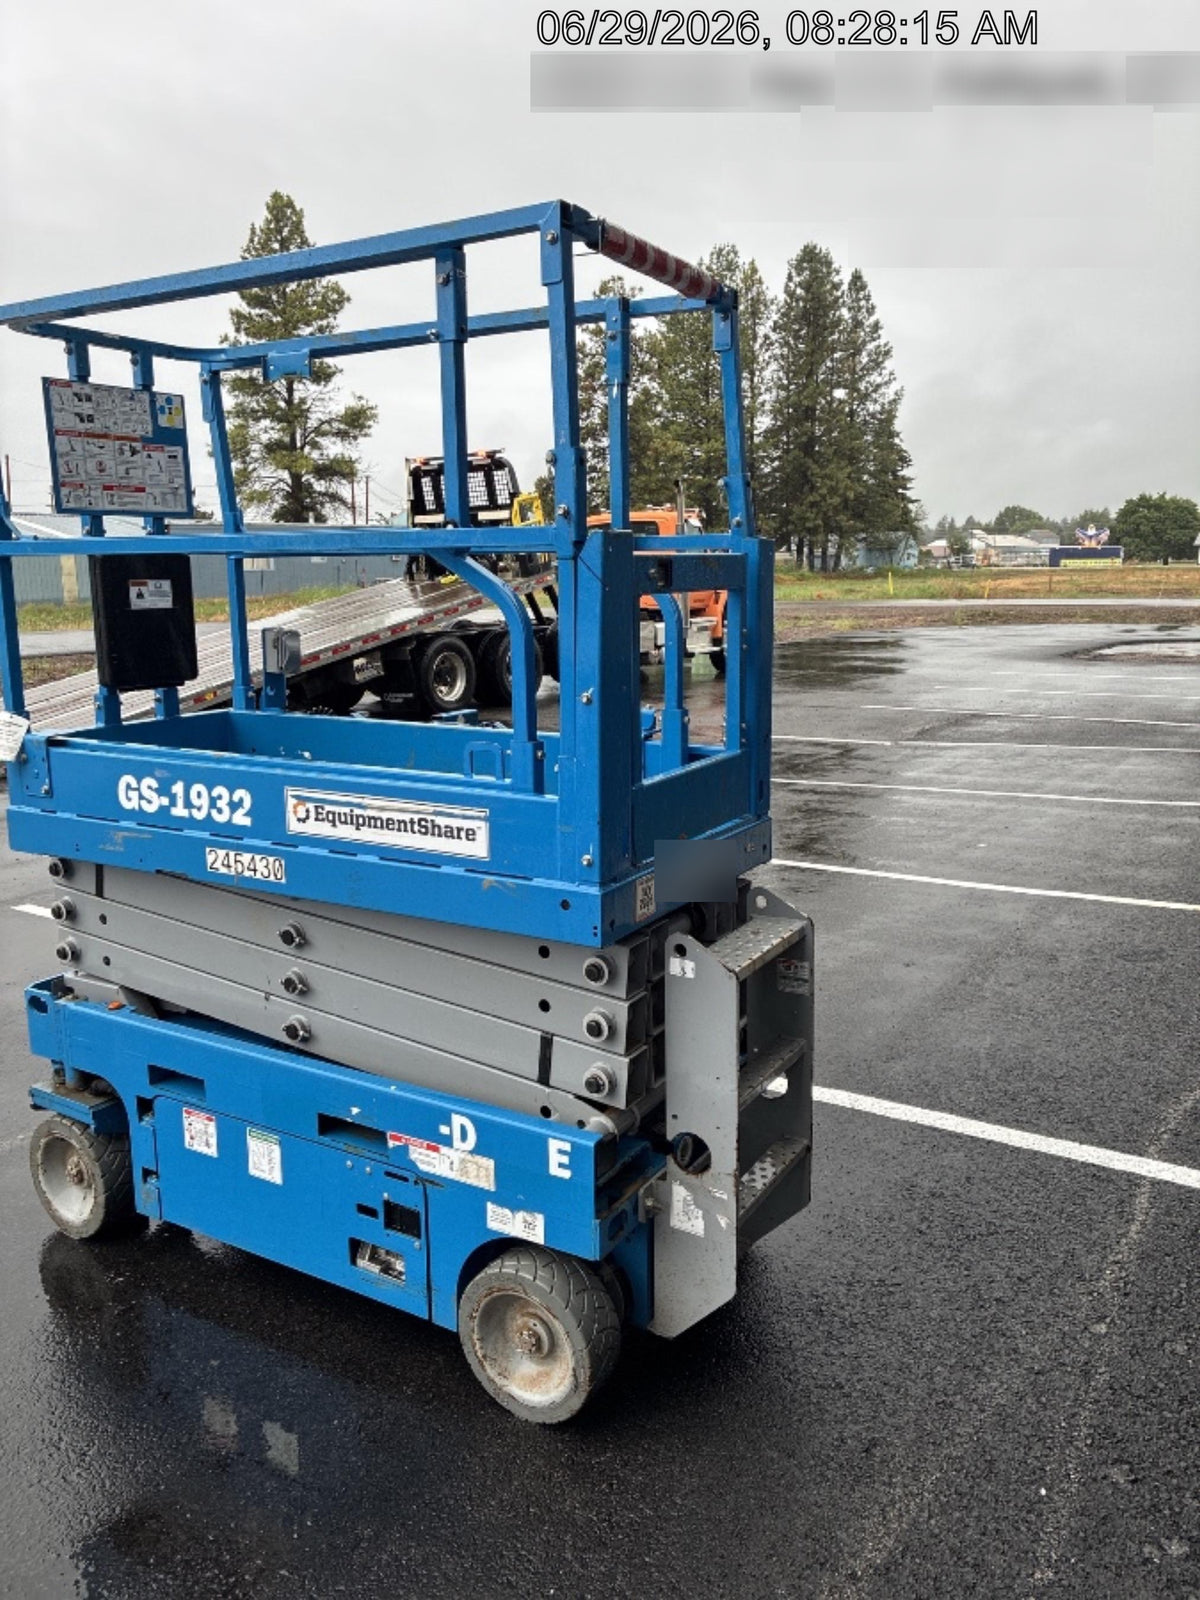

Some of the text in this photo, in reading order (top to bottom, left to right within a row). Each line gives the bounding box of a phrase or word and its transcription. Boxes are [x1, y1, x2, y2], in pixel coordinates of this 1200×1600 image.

[117, 774, 252, 827] GS-1932
[313, 804, 477, 842] EquipmentShare
[547, 1137, 572, 1180] E
